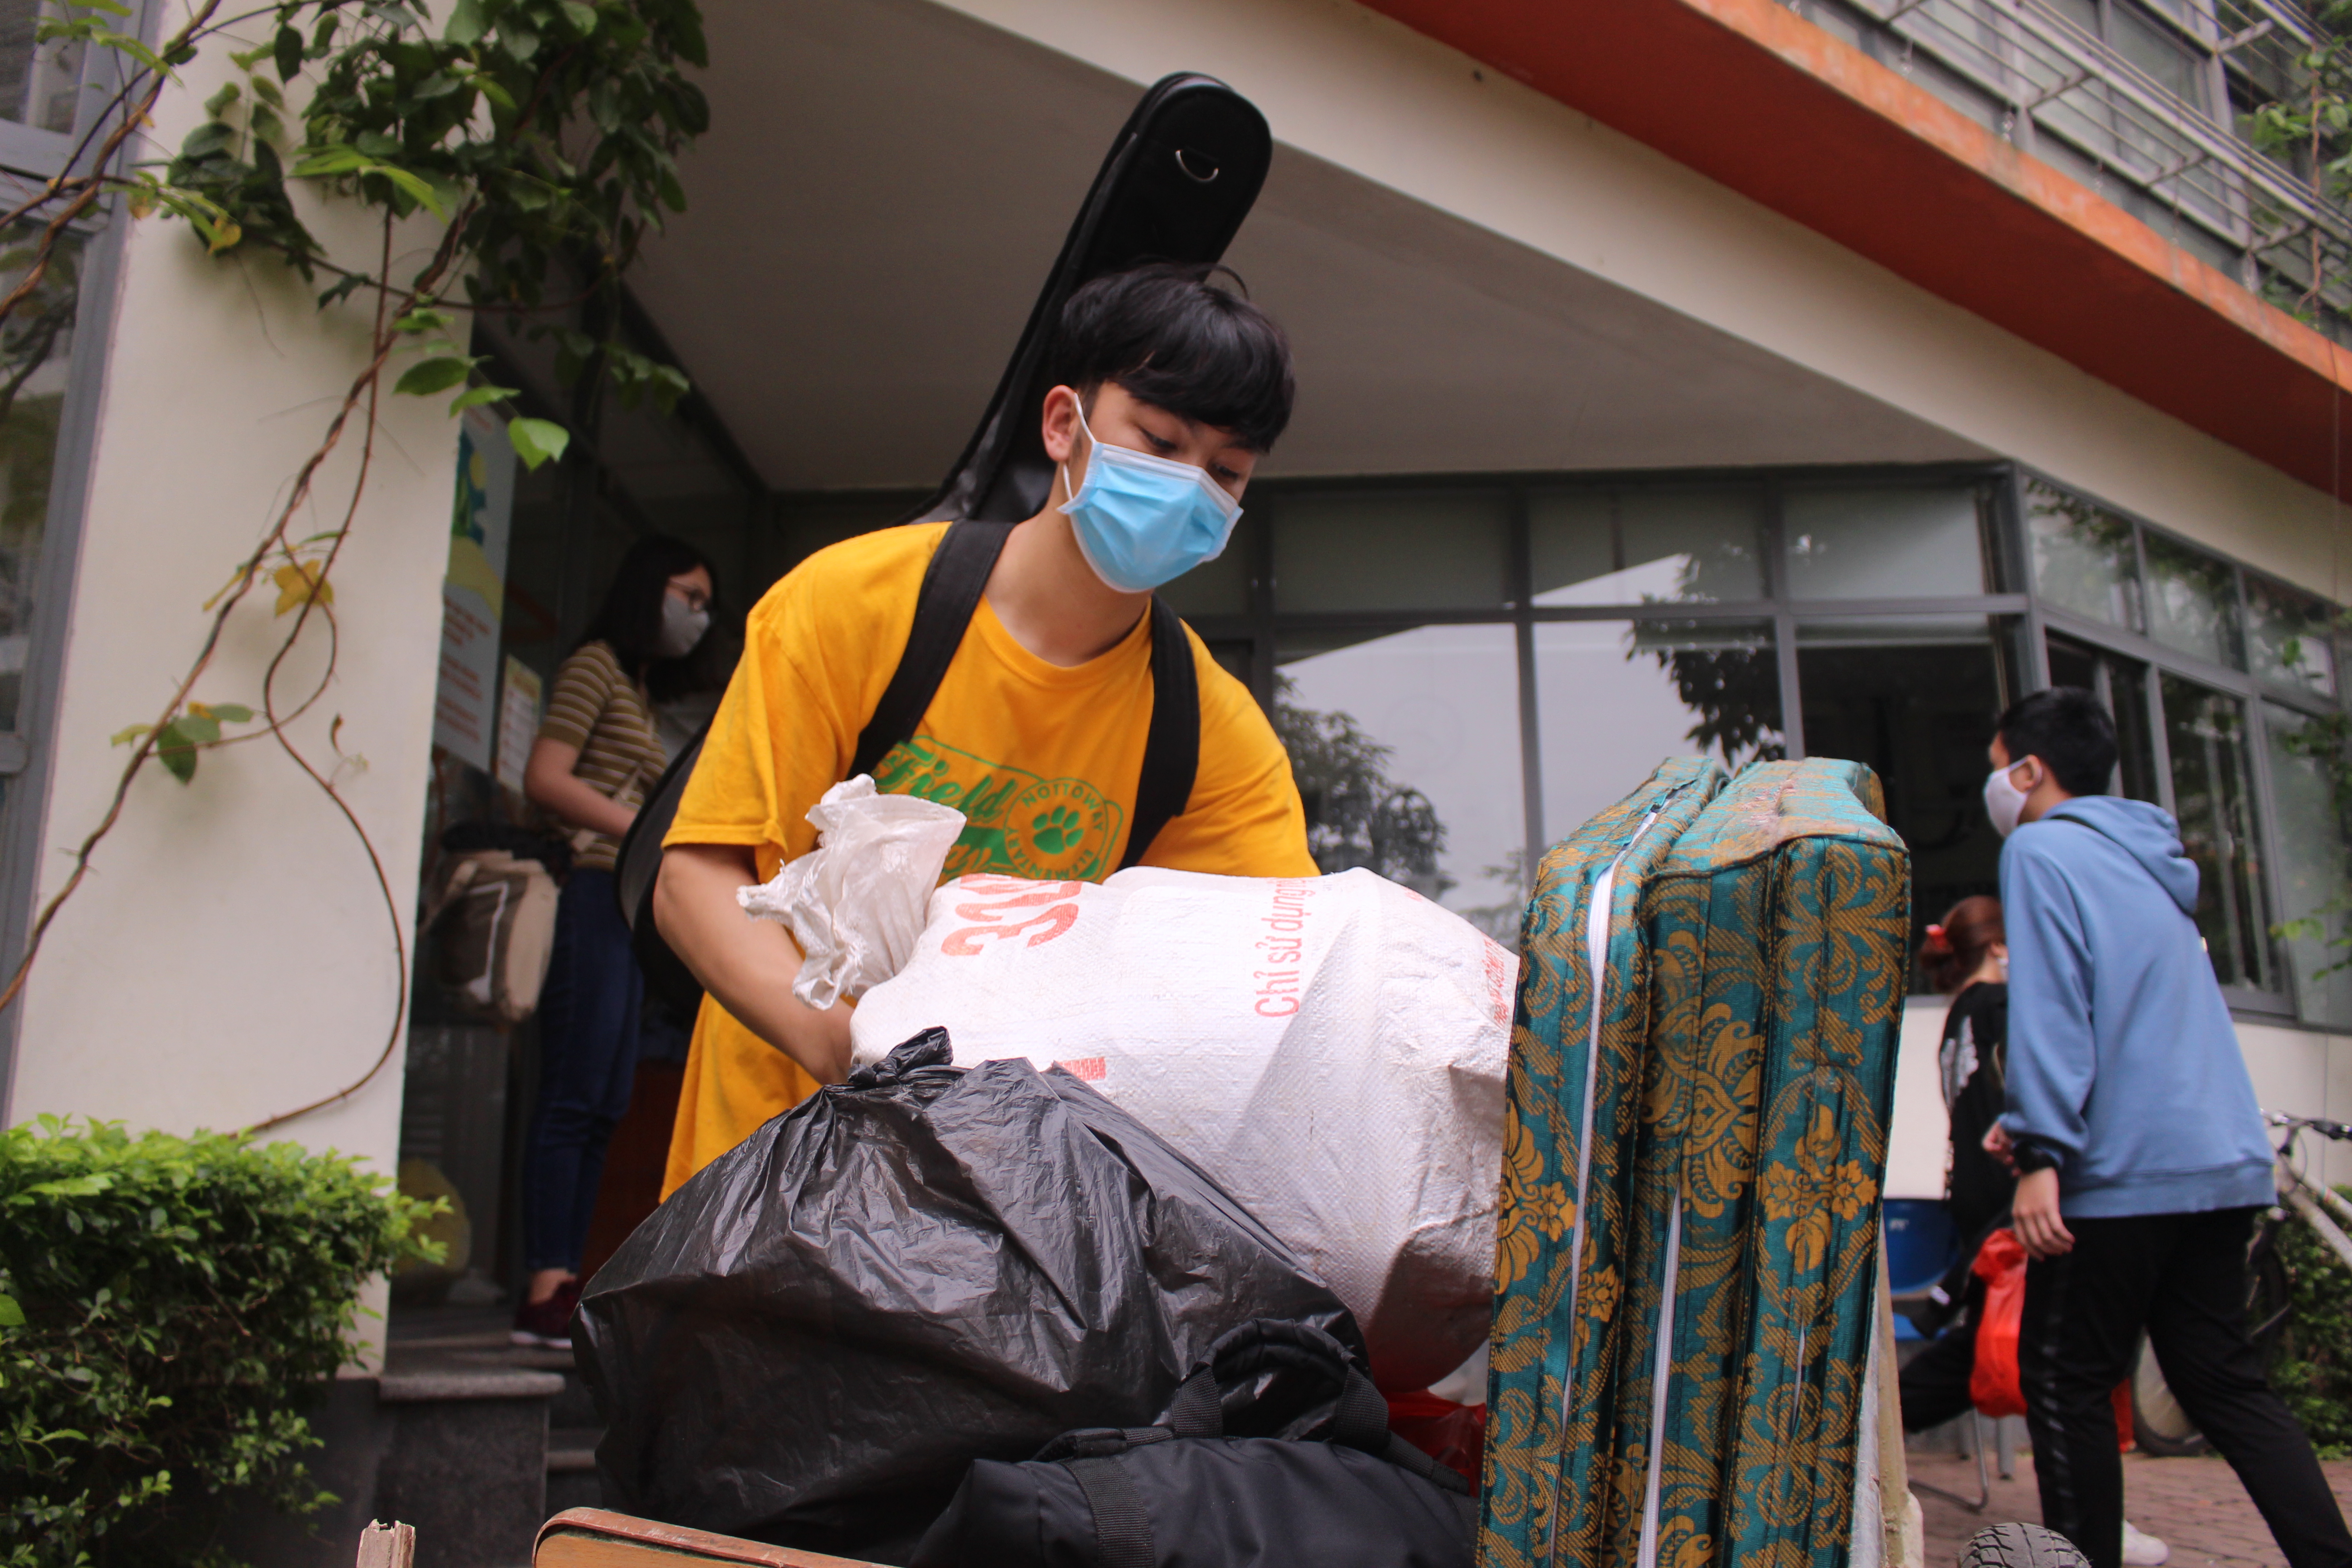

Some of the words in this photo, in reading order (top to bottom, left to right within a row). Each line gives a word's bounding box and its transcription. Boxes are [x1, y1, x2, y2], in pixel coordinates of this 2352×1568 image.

[872, 741, 1018, 824] Field
[1022, 783, 1103, 831] NOTTOWAY
[1007, 827, 1094, 880] ELEMENTARY
[1260, 888, 1316, 931] dụng
[1254, 936, 1302, 963] sử
[1253, 970, 1300, 1017] Chỉ
